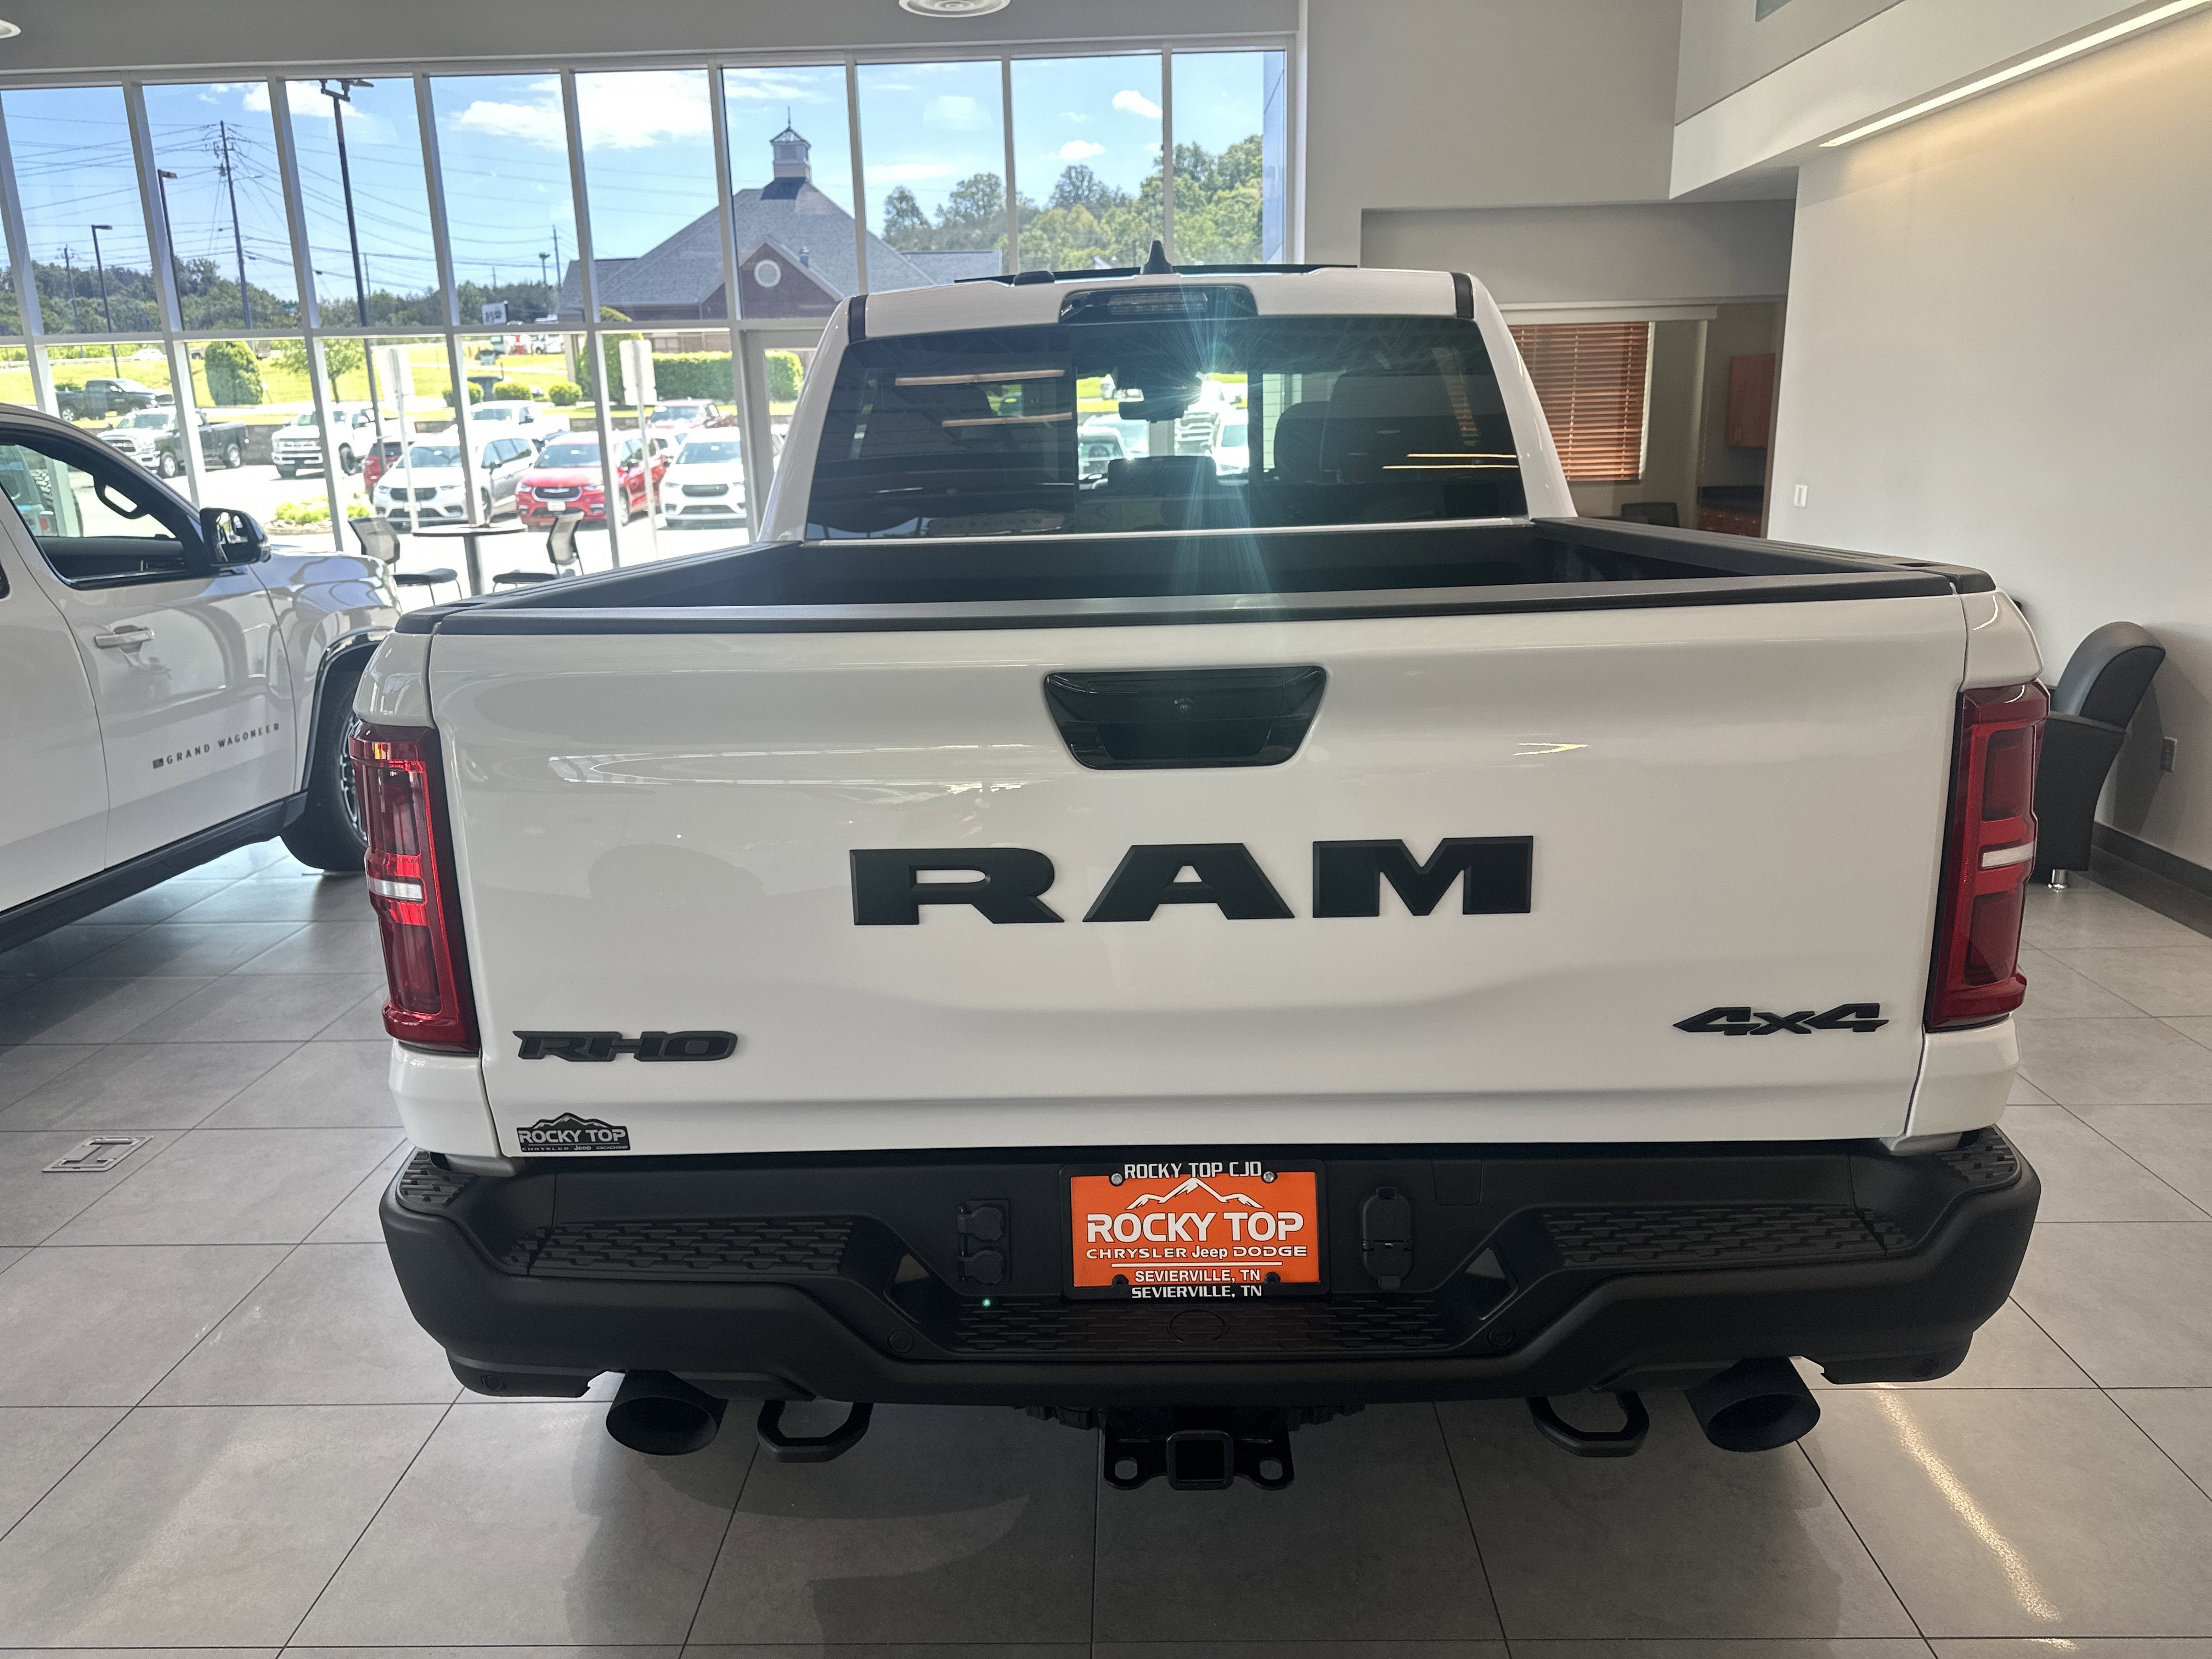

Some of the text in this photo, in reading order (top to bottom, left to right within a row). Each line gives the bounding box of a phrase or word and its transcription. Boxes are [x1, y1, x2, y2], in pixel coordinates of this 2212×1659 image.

[166, 723, 279, 764] GRAND WAGONEER
[849, 835, 1534, 926] RAM
[1673, 1002, 1889, 1036] 4x4
[512, 1030, 738, 1062] RHO
[518, 1129, 626, 1143] ROCKY TOP
[1124, 1161, 1262, 1179] ROCKY TOP CJD
[1087, 1211, 1304, 1243] ROCKY TOP
[1086, 1245, 1307, 1259] CHRYSLER Jeep DODGE
[1135, 1269, 1260, 1283] SEVIERVILLE, TN
[1131, 1284, 1262, 1299] SEVIERVILLE, TN
